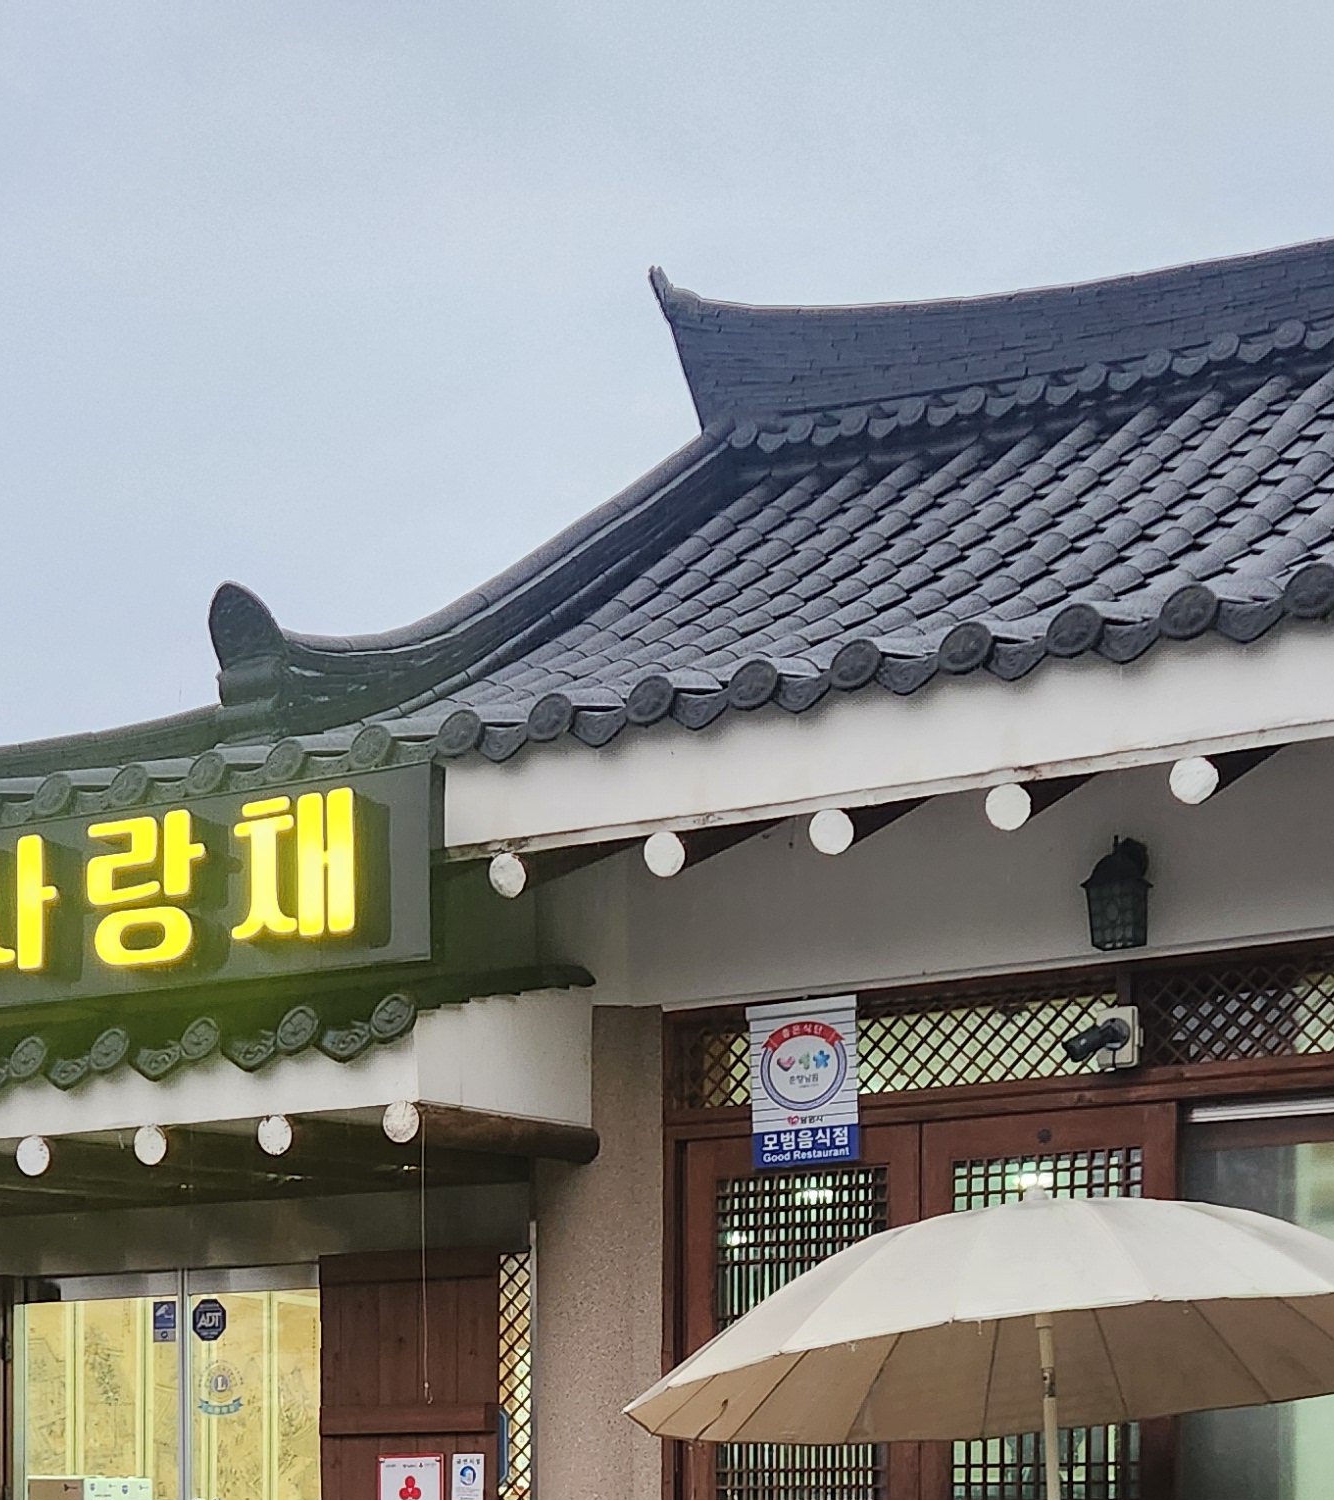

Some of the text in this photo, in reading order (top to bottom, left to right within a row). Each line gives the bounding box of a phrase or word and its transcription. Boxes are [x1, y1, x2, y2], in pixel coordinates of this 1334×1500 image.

[762, 1126, 849, 1151] 모범음식점
[763, 1147, 850, 1163] Good Restaurant
[197, 1312, 222, 1328] ADT
